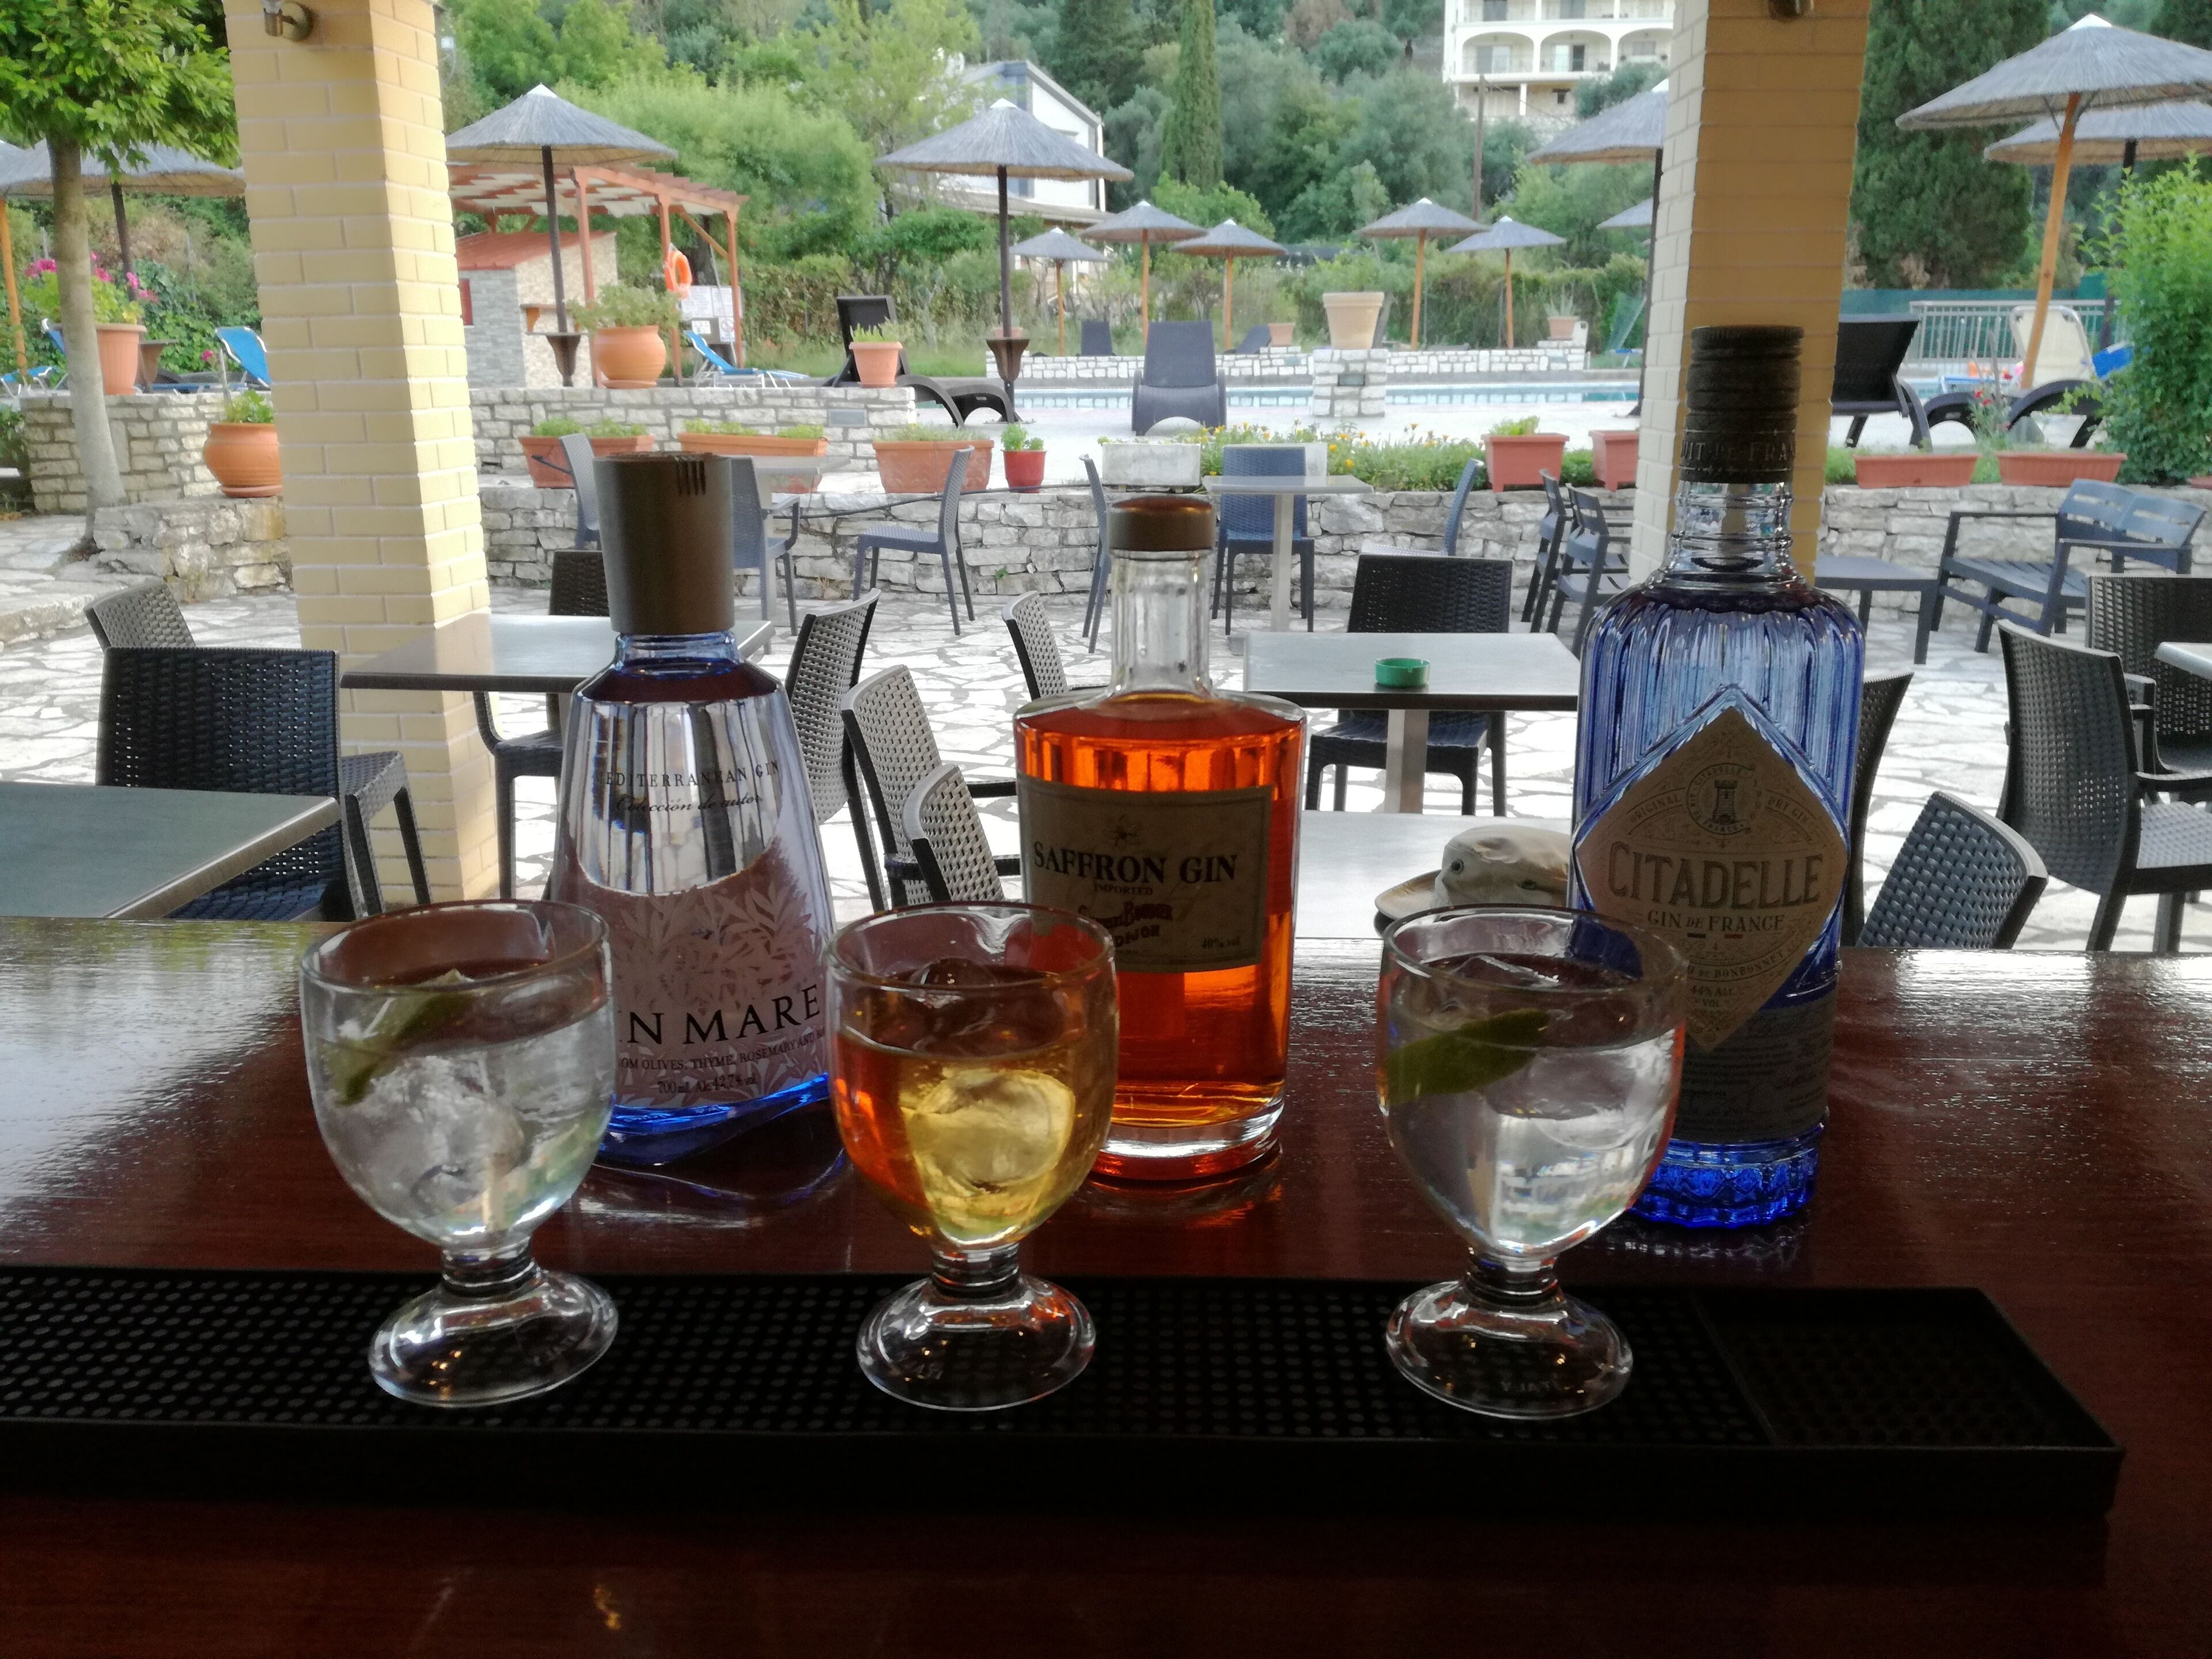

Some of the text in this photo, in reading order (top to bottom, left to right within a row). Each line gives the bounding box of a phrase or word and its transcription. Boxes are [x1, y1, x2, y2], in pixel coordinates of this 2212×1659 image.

[596, 767, 747, 787] MEDITERRANEAN
[1630, 793, 1681, 822] ORIGINAL
[1033, 841, 1237, 884] SAFFRON GIN
[1608, 840, 1824, 910] CITADELLE
[1093, 883, 1153, 896] IMPORTED
[1646, 910, 1785, 932] GIN DE FRANCE
[682, 983, 821, 1045] MARE
[739, 1039, 797, 1063] ROSEMARY
[797, 1032, 815, 1047] AND
